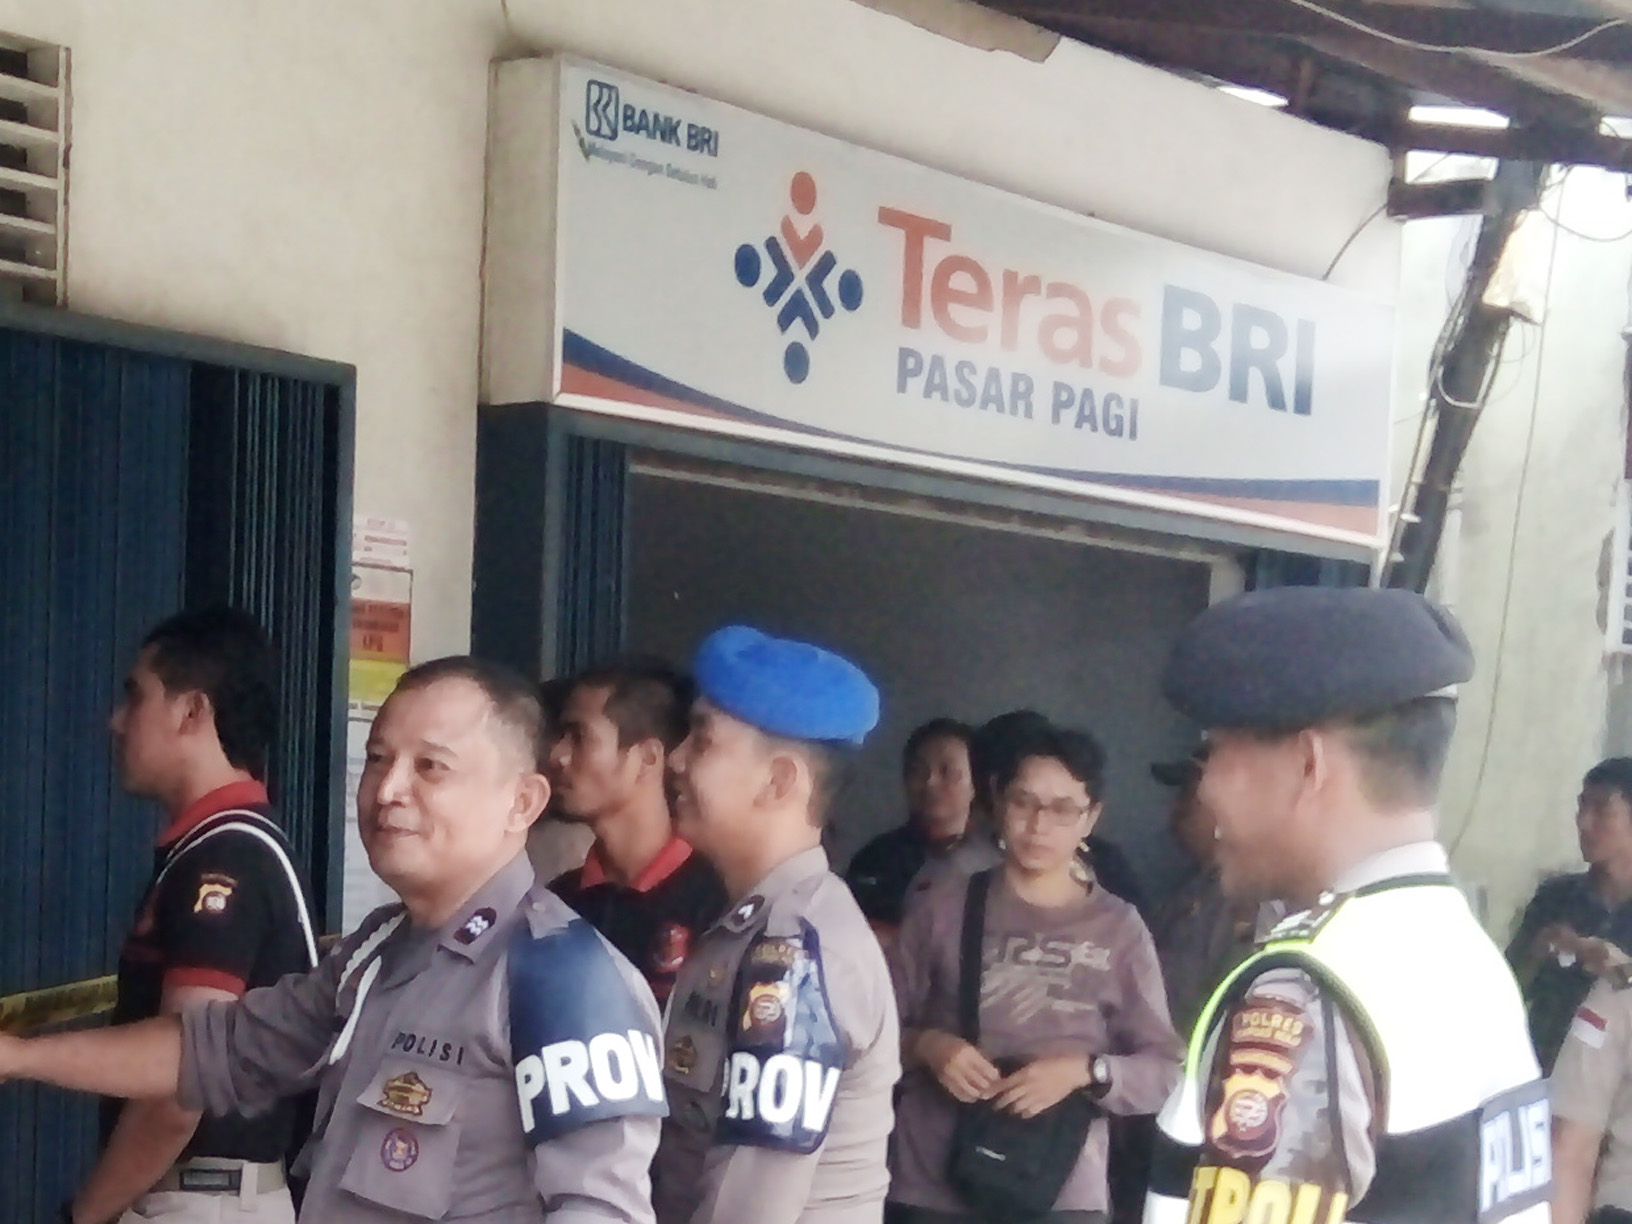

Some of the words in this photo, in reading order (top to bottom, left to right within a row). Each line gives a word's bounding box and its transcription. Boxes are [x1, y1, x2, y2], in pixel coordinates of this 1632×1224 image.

[623, 104, 682, 146] BANK
[687, 123, 719, 157] BRI
[877, 207, 1142, 378] Teras
[1158, 284, 1316, 417] BRI
[897, 347, 1034, 420] PASAR
[1052, 382, 1139, 441] PAGI
[391, 1032, 464, 1065] POLISI
[515, 1029, 664, 1133] PROV
